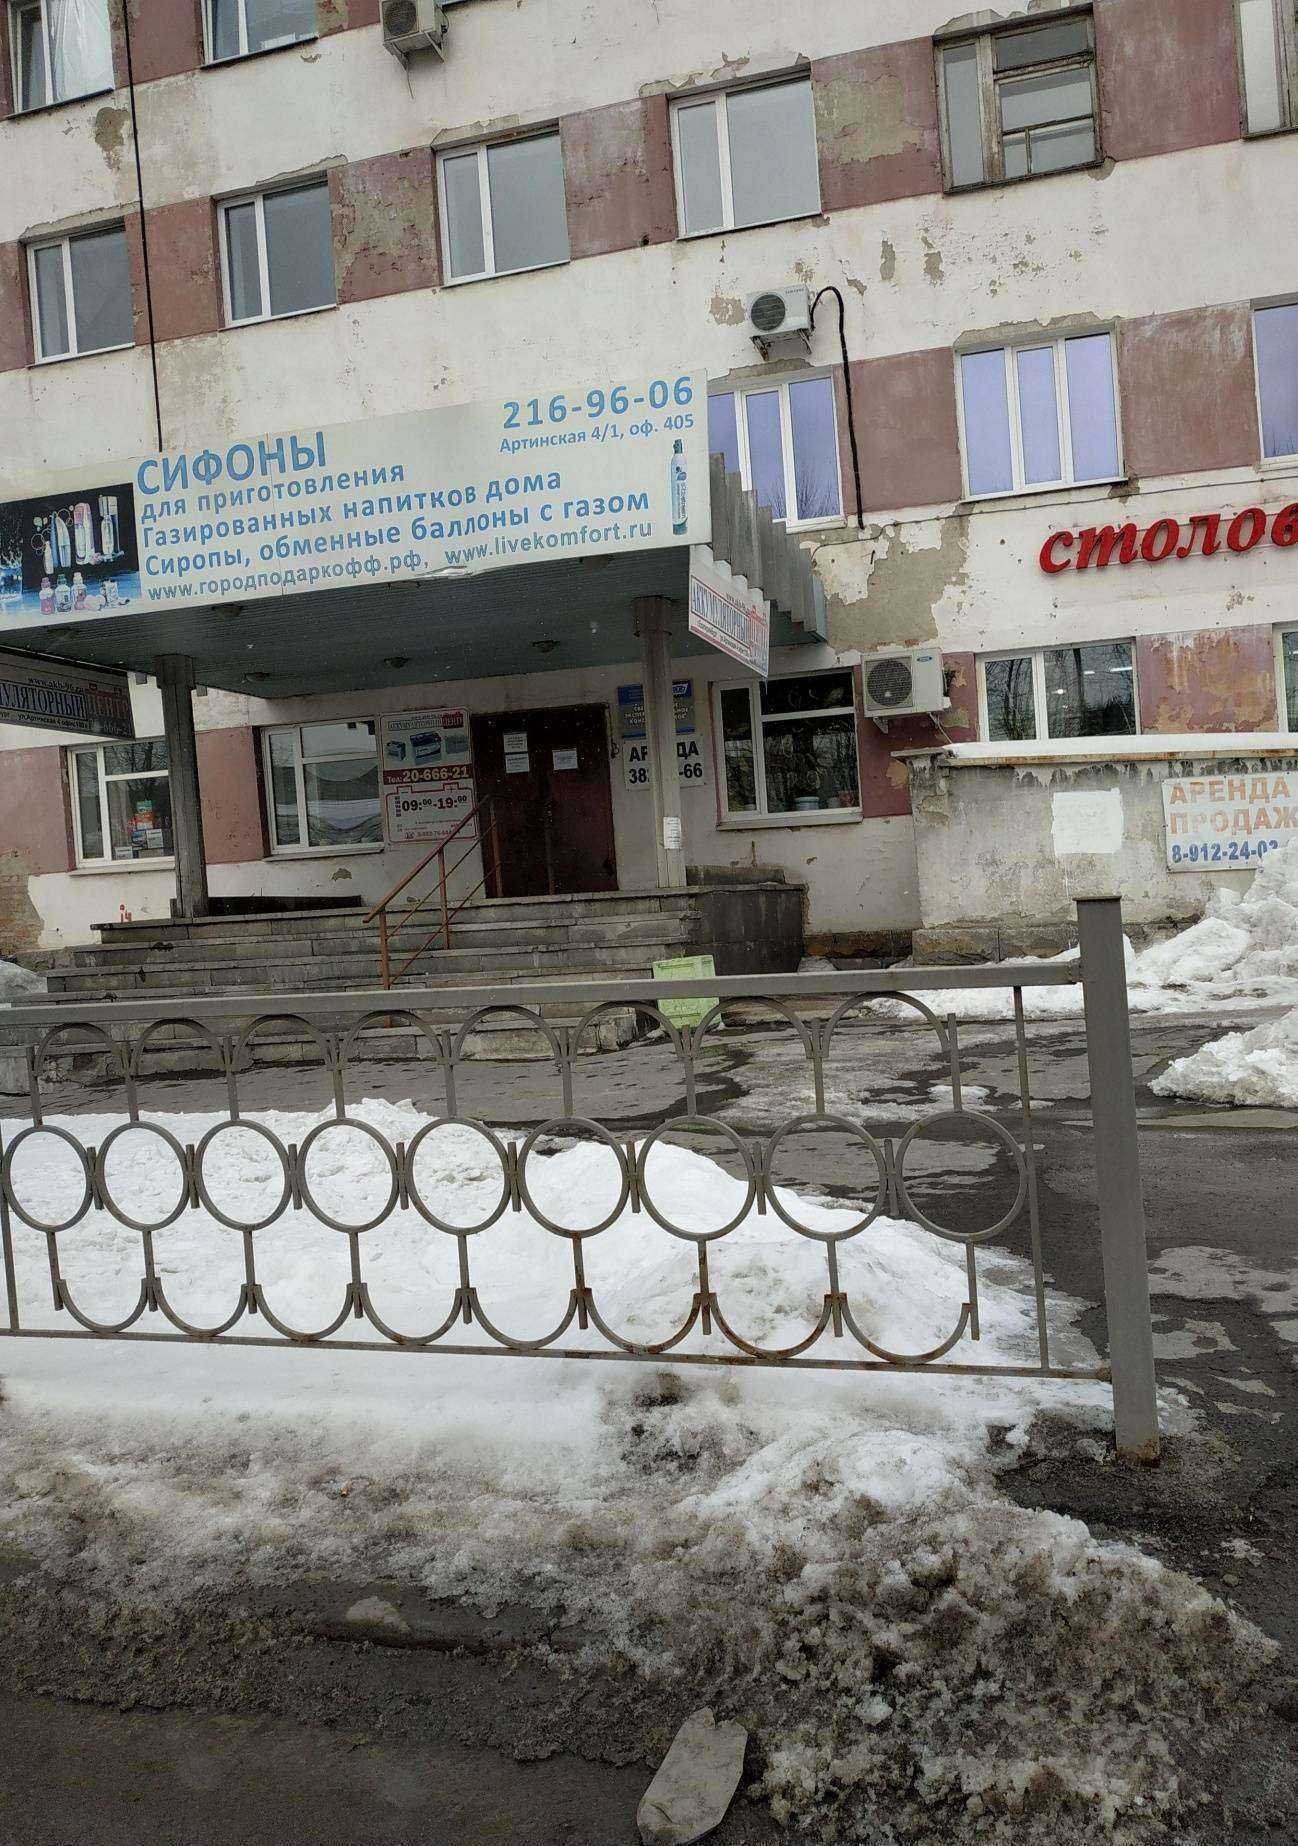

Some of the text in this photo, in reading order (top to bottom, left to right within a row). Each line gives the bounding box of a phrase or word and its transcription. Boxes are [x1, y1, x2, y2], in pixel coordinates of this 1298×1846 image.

[503, 376, 693, 429] 216-96-06
[499, 413, 694, 455] Артинская 4/1, оф. 405
[137, 431, 326, 495] СИФОНЫ
[141, 464, 405, 524] для приготовления
[143, 472, 562, 548] Газированных напитков дома
[145, 548, 251, 577] Сиропы,
[259, 526, 401, 561] обменные
[411, 507, 529, 541] баллоны
[539, 503, 553, 522] с
[563, 492, 649, 520] газом
[148, 521, 652, 601] www.городподаркофф.рф, www.livekomfort.ru
[1039, 503, 1298, 573] столов
[403, 765, 469, 782] 20-666-21
[629, 741, 700, 762] АРДА
[1169, 776, 1290, 805] АРЕНДА
[1170, 806, 1298, 836] ПРОДАЖ
